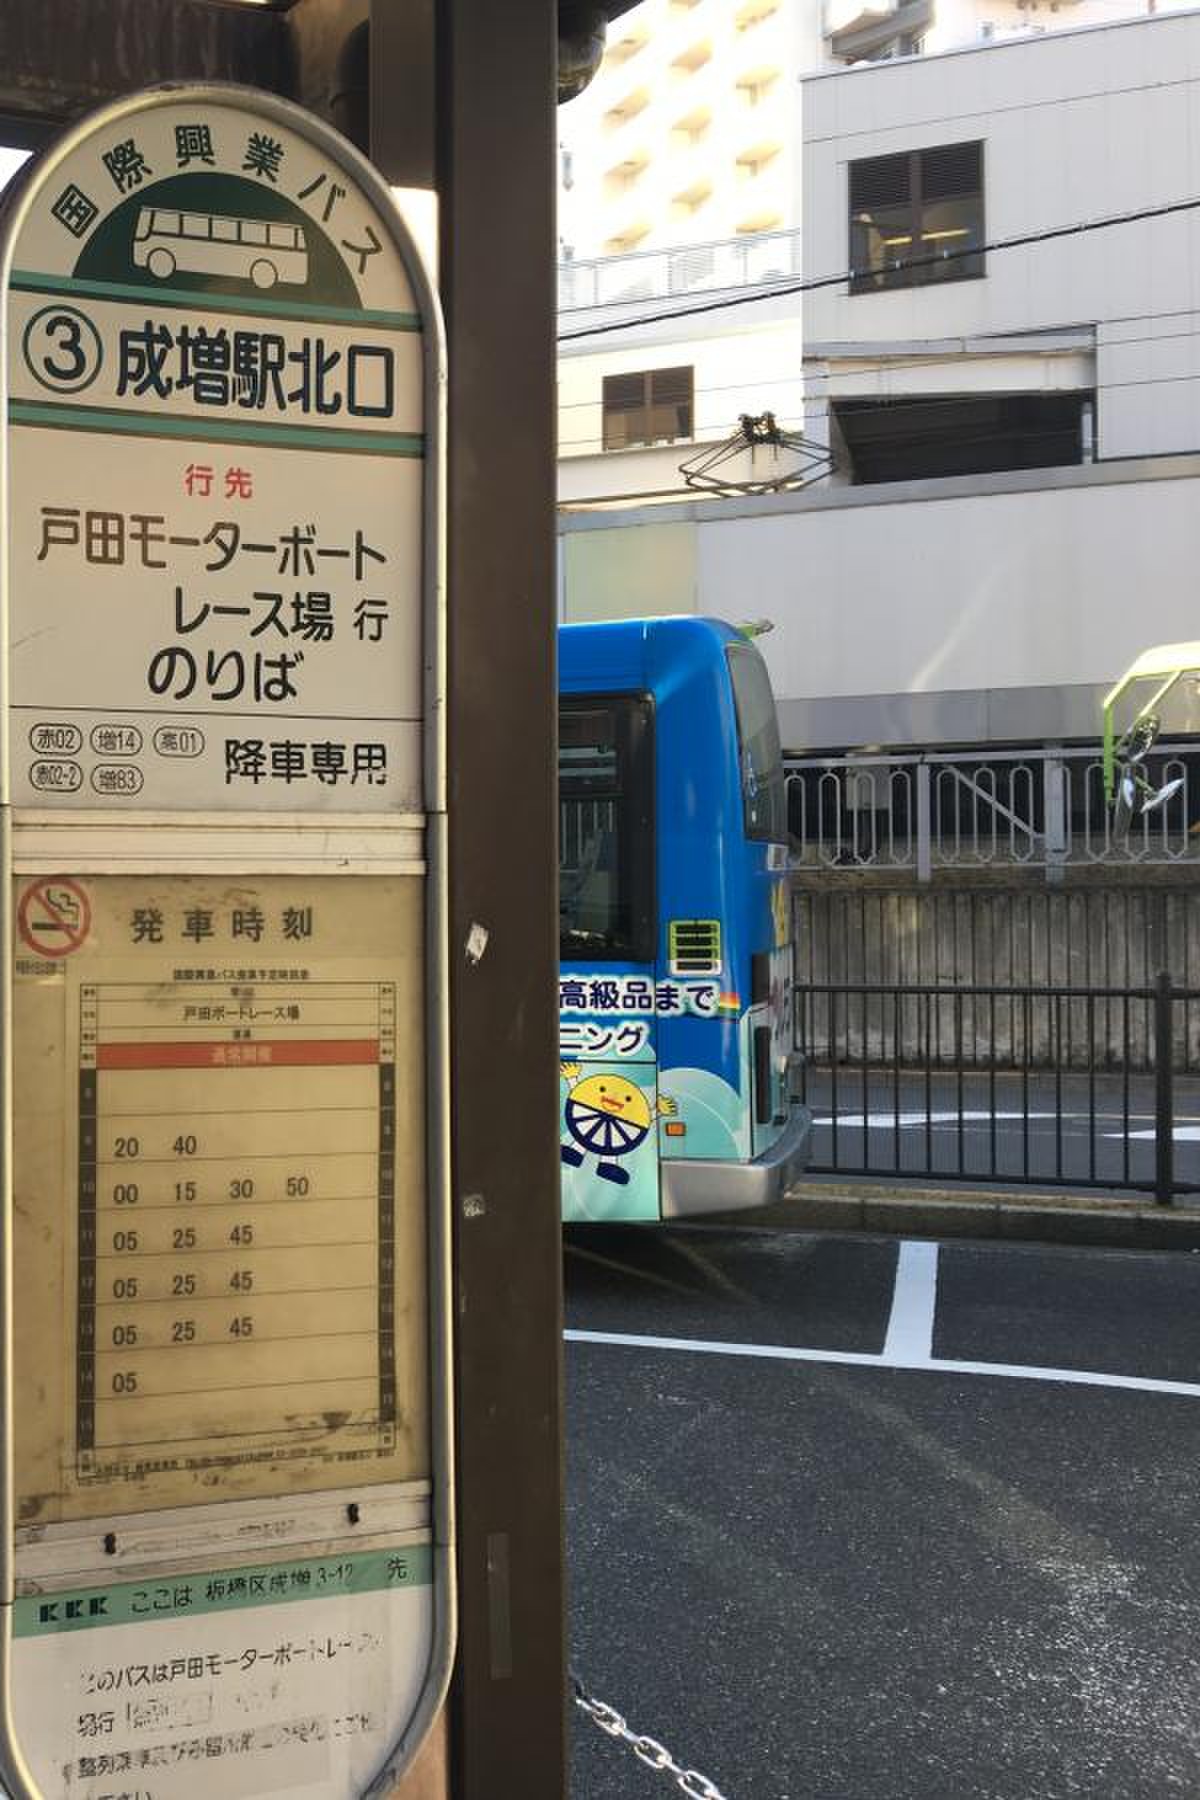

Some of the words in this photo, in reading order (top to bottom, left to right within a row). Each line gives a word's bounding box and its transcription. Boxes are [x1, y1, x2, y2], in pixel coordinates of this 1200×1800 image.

[51, 124, 382, 274] 国際興業バス
[116, 319, 394, 418] 成増駅北口
[185, 463, 253, 499] 行先
[37, 506, 387, 581] 戸田モーターボート
[175, 585, 335, 642] レース場
[353, 599, 389, 642] 行
[147, 646, 305, 702] のりば
[225, 739, 388, 786] 降車専用
[131, 906, 314, 944] 発車時刻
[114, 1137, 139, 1157] 20
[172, 1135, 197, 1155] 40
[113, 1183, 139, 1204] 00
[174, 1182, 196, 1202] 15
[229, 1179, 254, 1199] 30
[287, 1177, 309, 1197] 50
[113, 1231, 138, 1251] 05
[172, 1228, 196, 1249] 25
[229, 1225, 253, 1245] 45
[113, 1278, 138, 1298] 05
[172, 1275, 196, 1295] 25
[229, 1271, 253, 1291] 45
[112, 1325, 137, 1346] 05
[172, 1321, 196, 1342] 25
[229, 1317, 253, 1337] 45
[112, 1373, 138, 1393] 05
[132, 1585, 194, 1615] ここは
